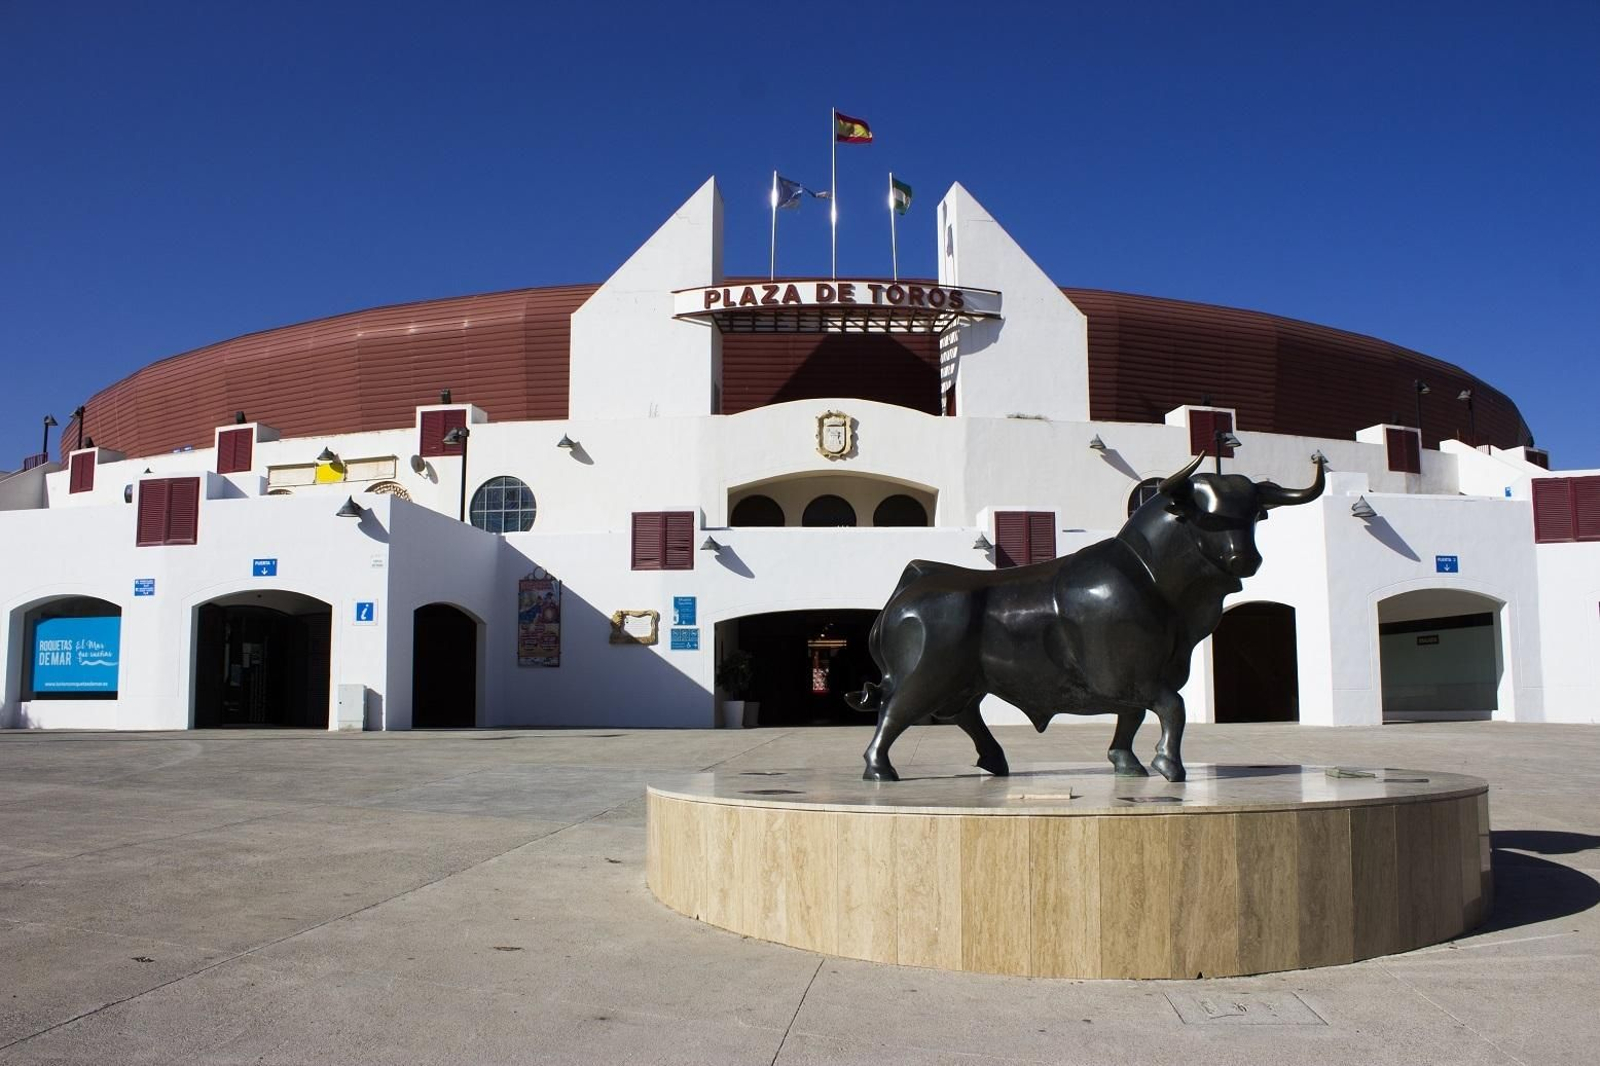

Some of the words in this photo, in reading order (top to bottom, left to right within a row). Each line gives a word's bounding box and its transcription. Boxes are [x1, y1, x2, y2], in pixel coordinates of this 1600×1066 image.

[704, 284, 802, 309] PLAZA
[815, 283, 857, 303] DE
[868, 284, 965, 309] TOROS
[40, 640, 72, 651] ROQUETAS
